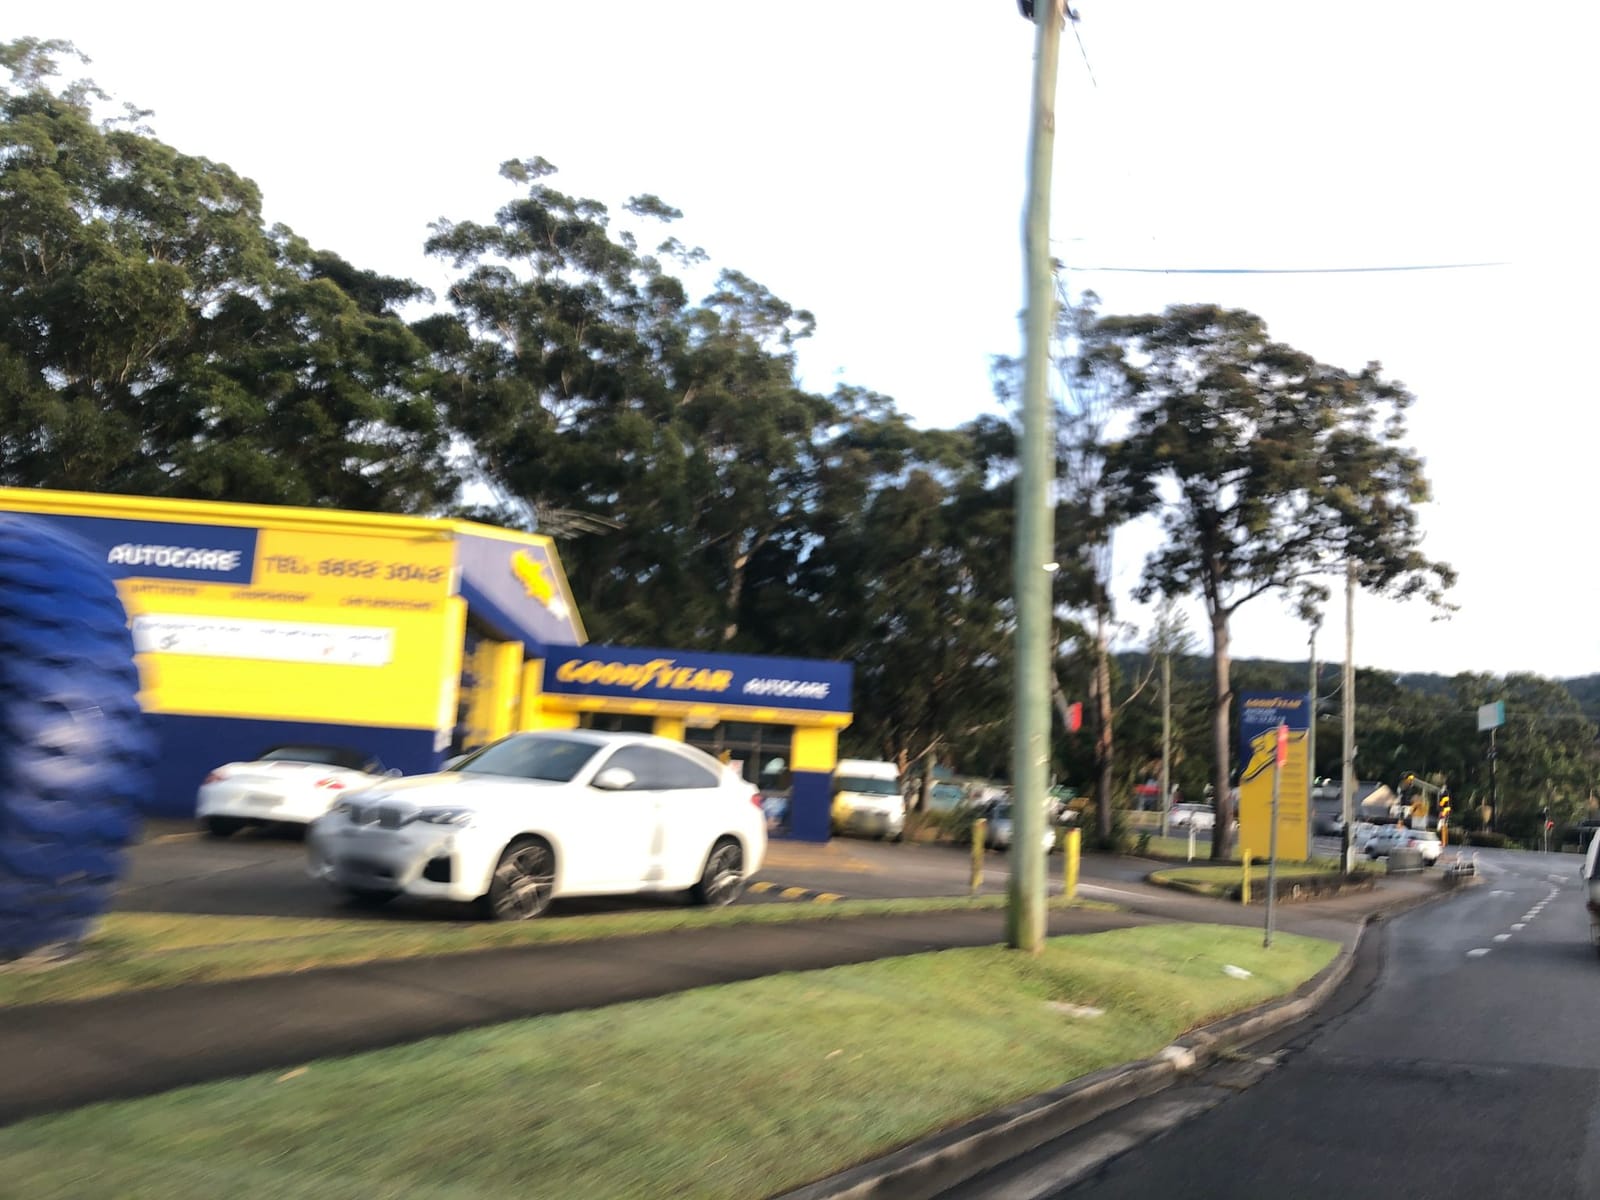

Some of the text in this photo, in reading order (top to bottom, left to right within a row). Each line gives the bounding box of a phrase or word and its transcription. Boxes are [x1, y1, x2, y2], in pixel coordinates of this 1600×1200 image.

[107, 543, 242, 572] AUTOCARE
[556, 658, 831, 700] GOODYEAR AUTOCARE
